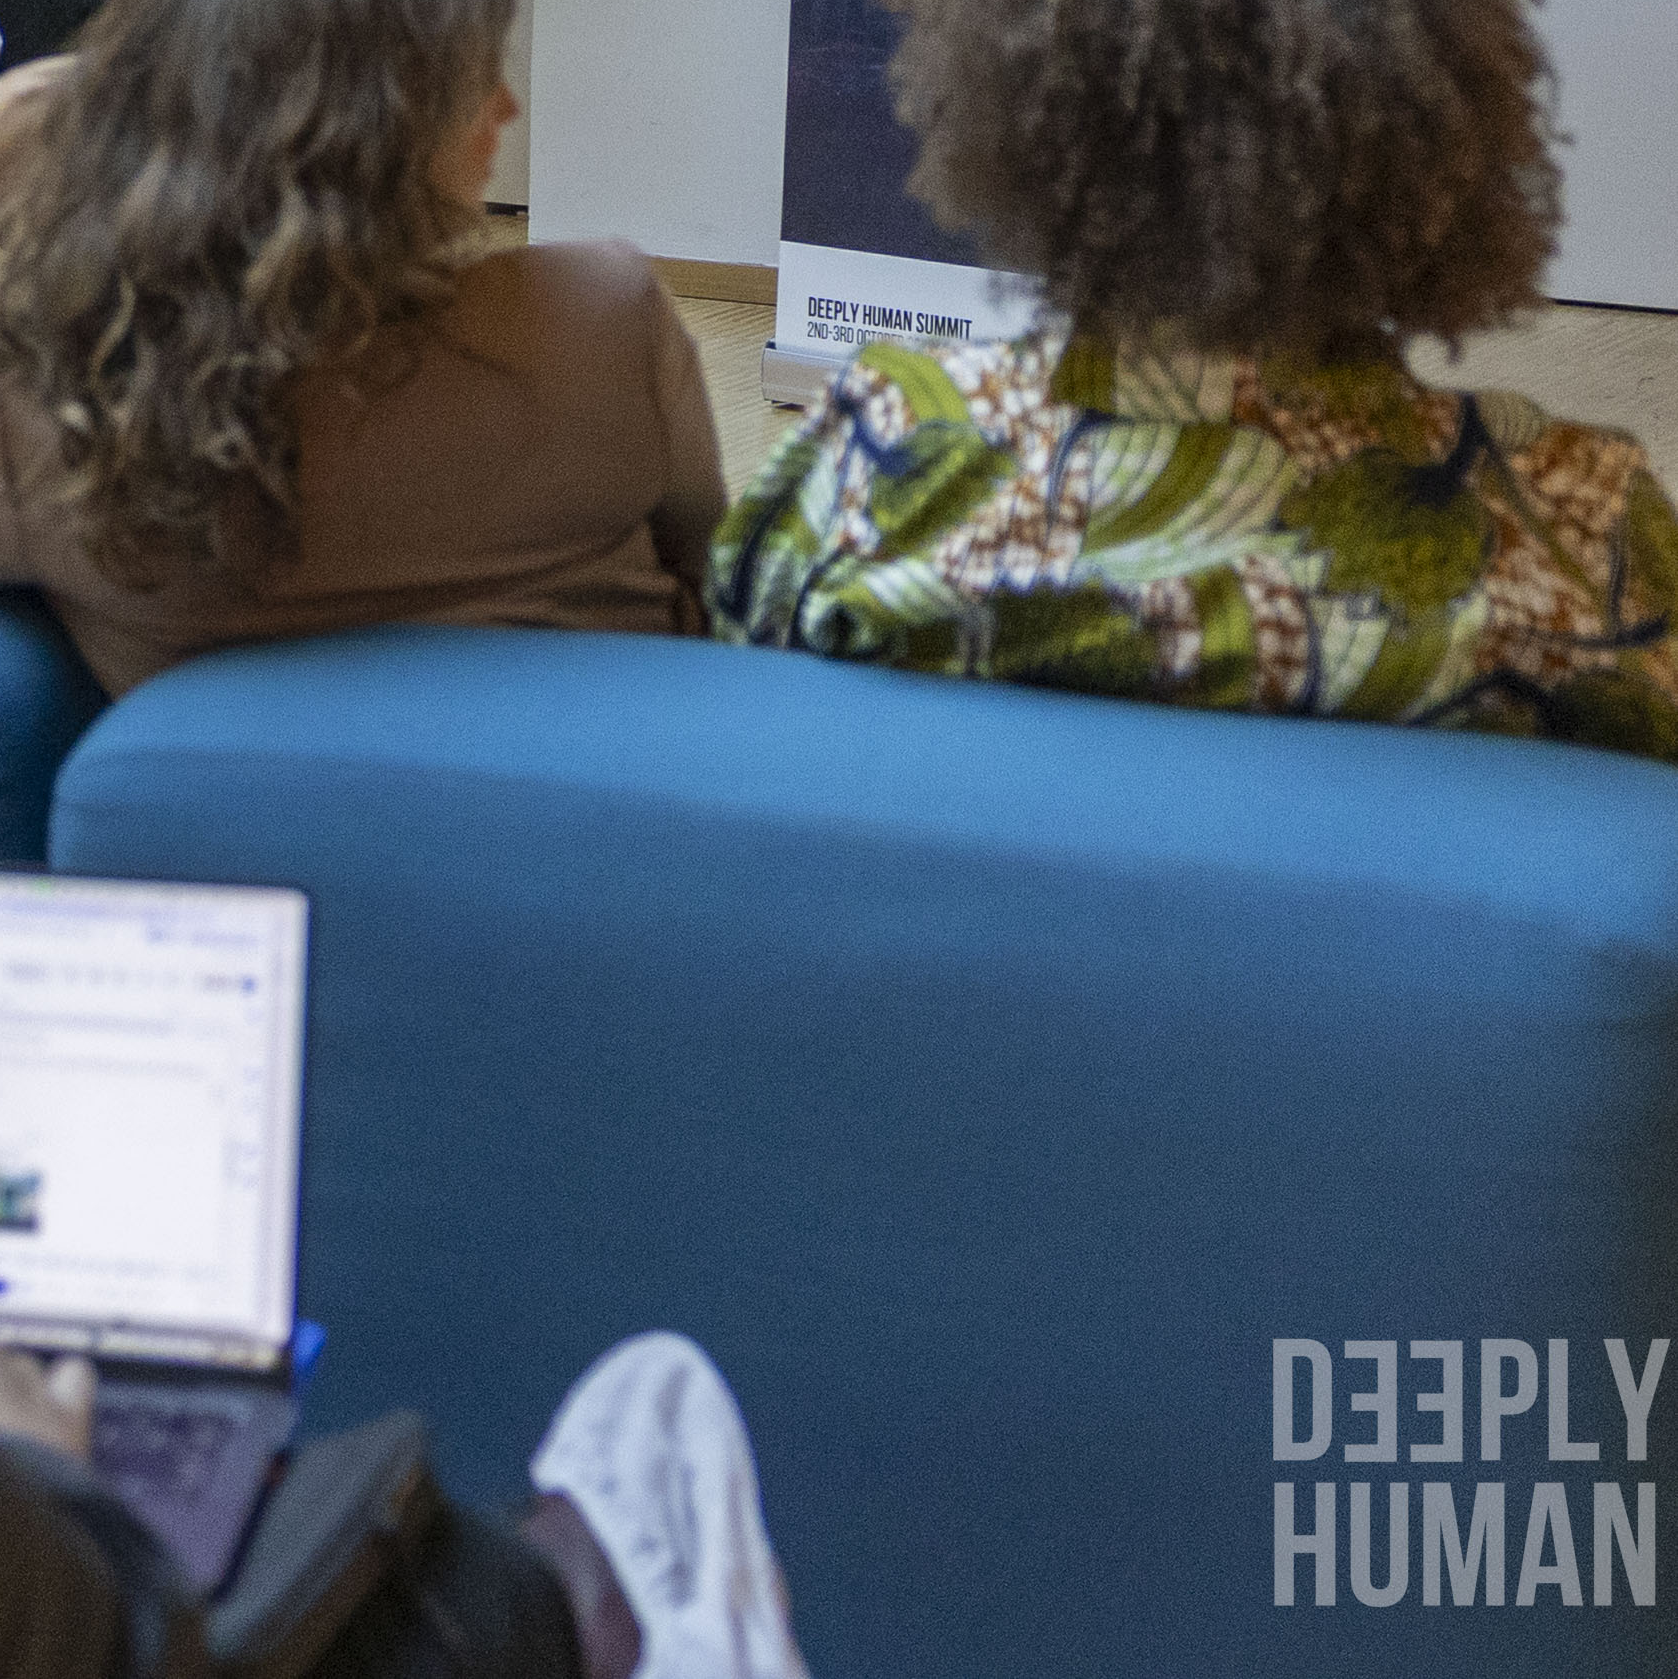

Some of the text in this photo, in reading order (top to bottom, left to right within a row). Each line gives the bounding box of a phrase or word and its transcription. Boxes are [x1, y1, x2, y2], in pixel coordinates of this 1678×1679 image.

[807, 321, 854, 344] 2ND-3RD
[808, 296, 973, 340] DEEPLY HUMAN SUMMIT
